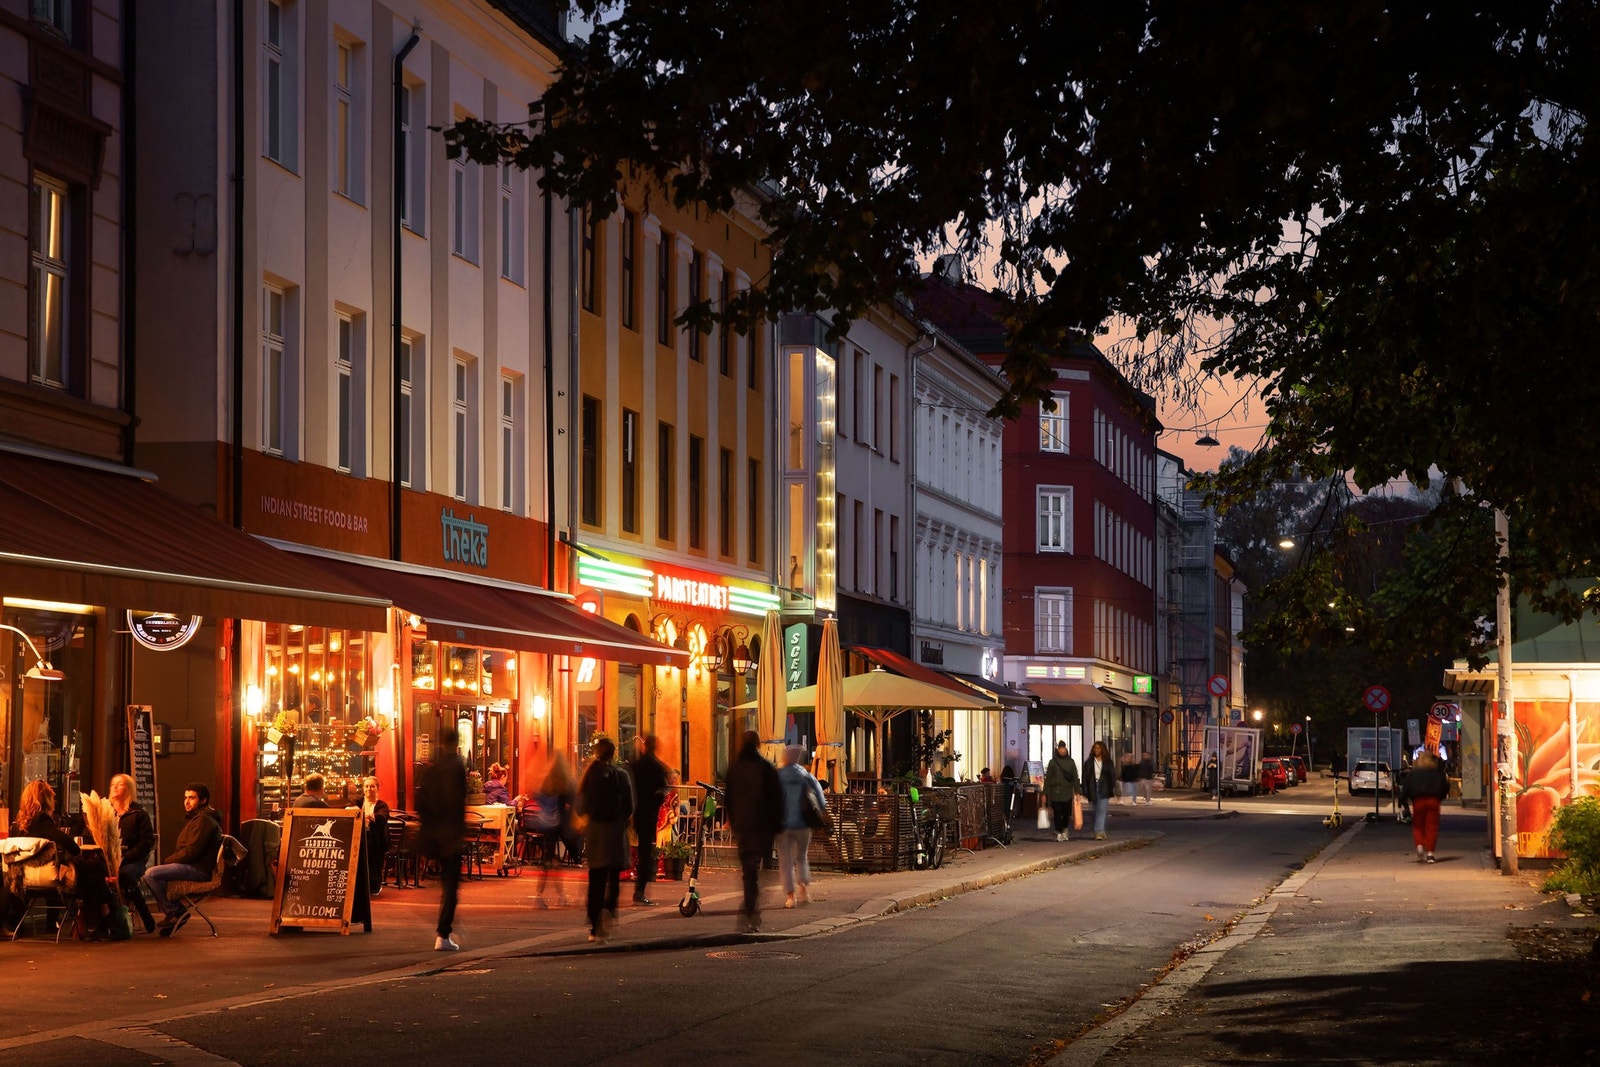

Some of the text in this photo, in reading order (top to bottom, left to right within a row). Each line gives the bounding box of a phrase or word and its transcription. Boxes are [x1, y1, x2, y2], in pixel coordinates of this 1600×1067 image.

[261, 495, 368, 534] INDIAN STREET FOOD & BAR
[440, 506, 489, 569] theka
[657, 574, 729, 611] PARKTEATRET
[1435, 707, 1447, 716] 30
[299, 848, 345, 860] OPENING
[302, 860, 337, 869] HOURS
